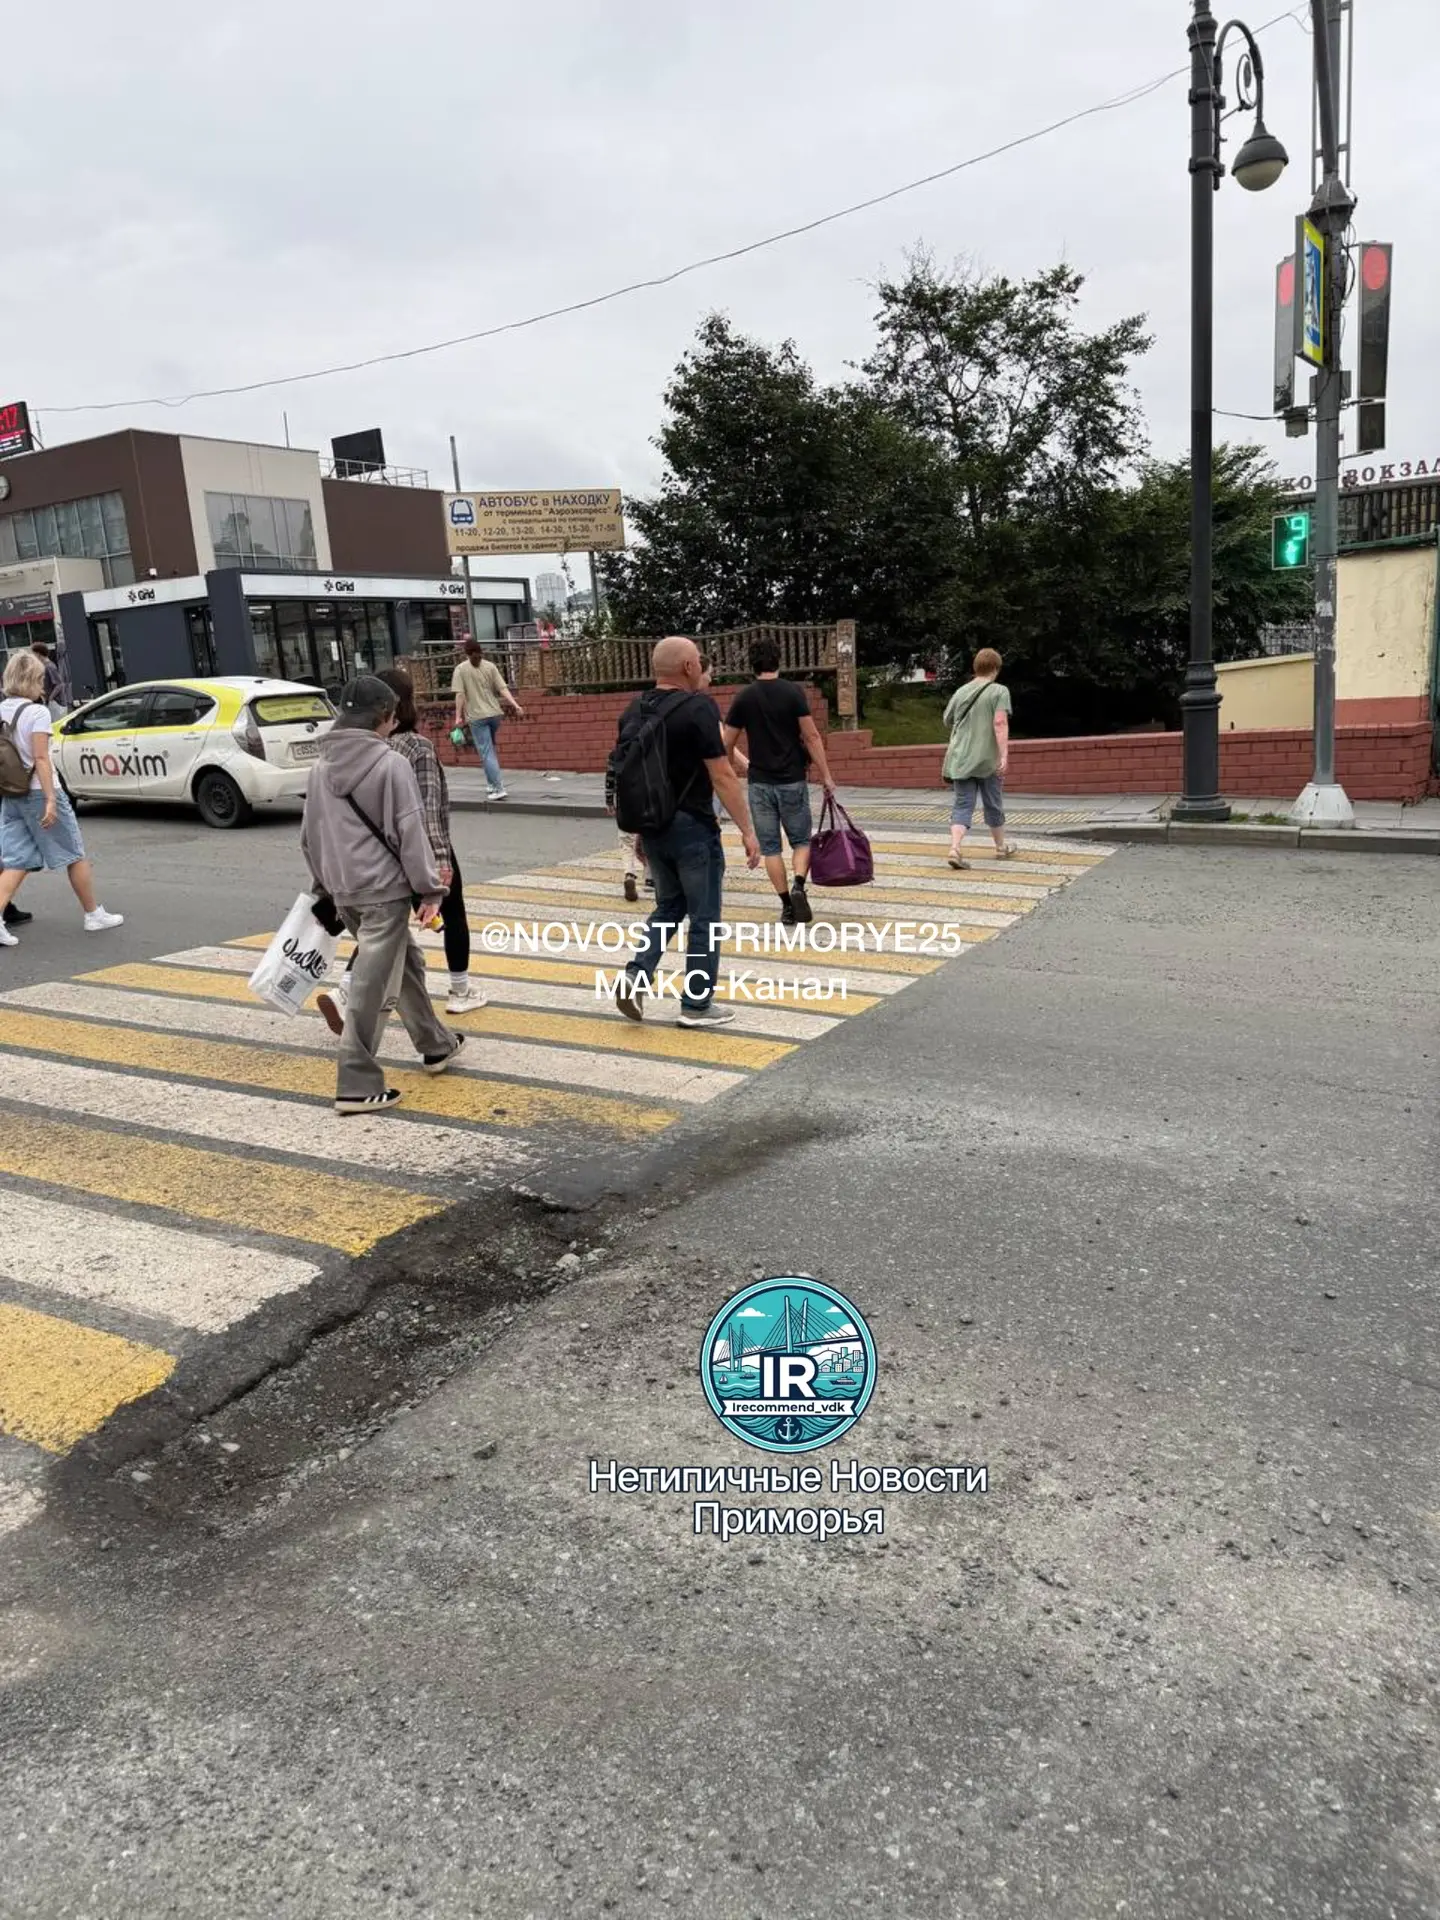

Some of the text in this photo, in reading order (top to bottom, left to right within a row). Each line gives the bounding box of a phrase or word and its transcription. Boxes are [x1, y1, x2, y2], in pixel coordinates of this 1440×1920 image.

[479, 494, 610, 508] АВТОБУС в НАХОДКУ
[495, 509, 542, 517] терминала
[1290, 516, 1306, 540] 9
[335, 580, 355, 592] Grid
[138, 589, 155, 601] Grid
[79, 747, 168, 777] maxim
